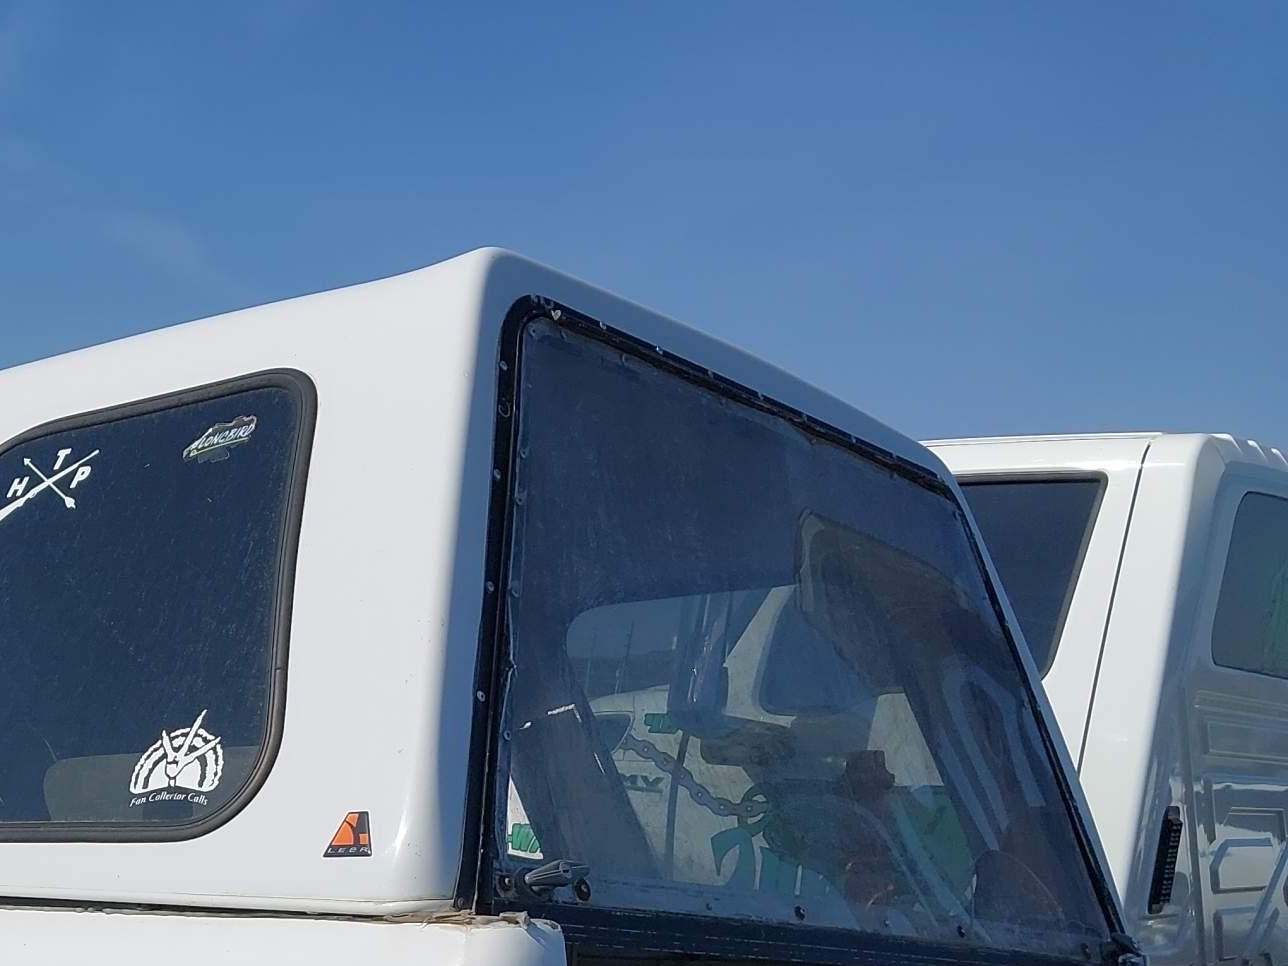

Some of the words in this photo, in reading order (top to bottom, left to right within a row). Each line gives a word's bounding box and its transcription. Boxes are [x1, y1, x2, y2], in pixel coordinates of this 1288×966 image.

[129, 797, 146, 807] Fan
[148, 791, 187, 802] Collector
[187, 792, 209, 806] Calls
